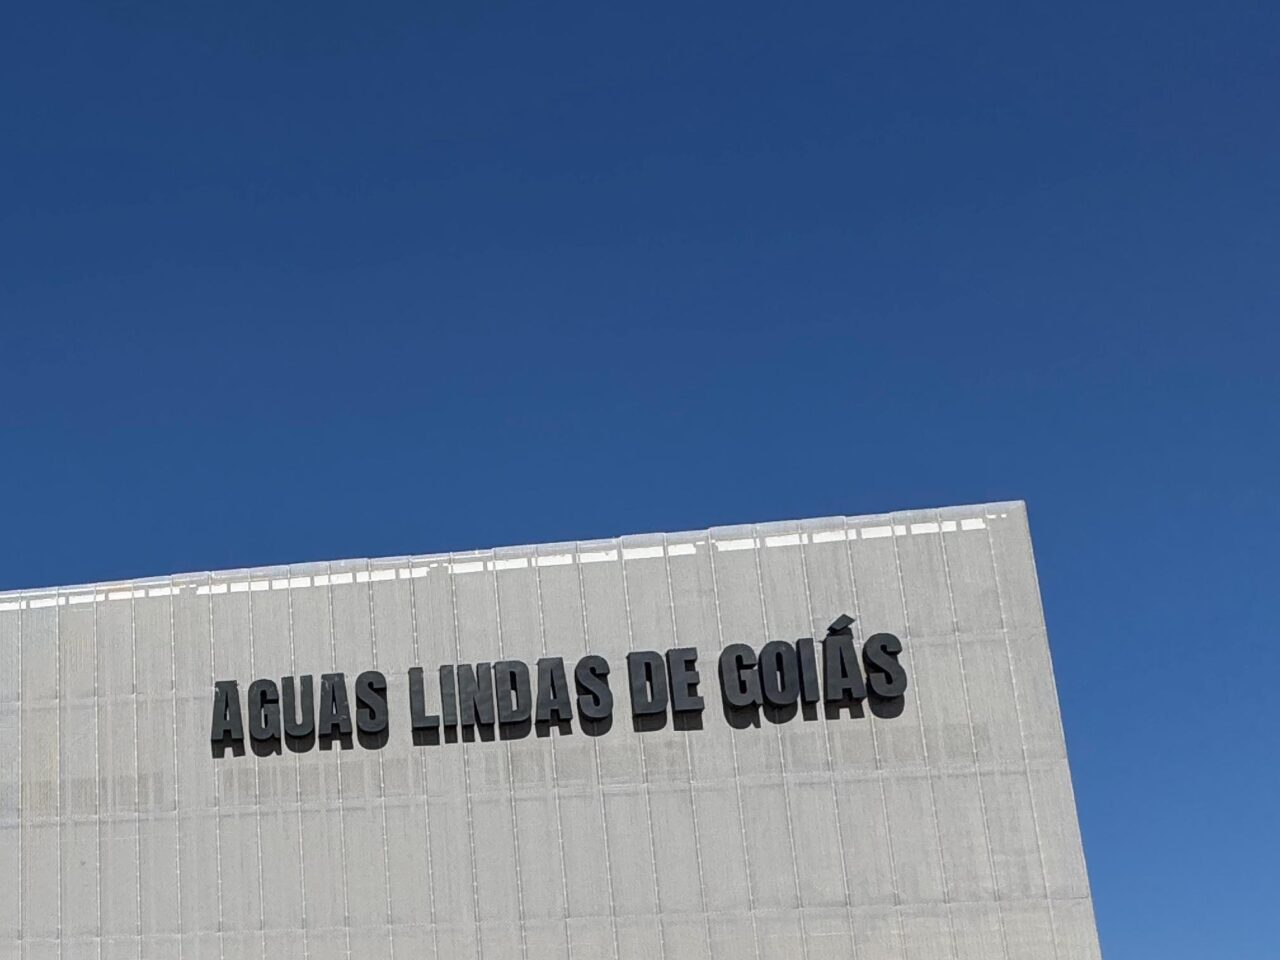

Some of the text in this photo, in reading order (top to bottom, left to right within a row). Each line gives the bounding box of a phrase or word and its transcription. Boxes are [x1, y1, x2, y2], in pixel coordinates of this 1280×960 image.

[211, 614, 907, 742] AGUAS LINDAS DE GOIÁS
